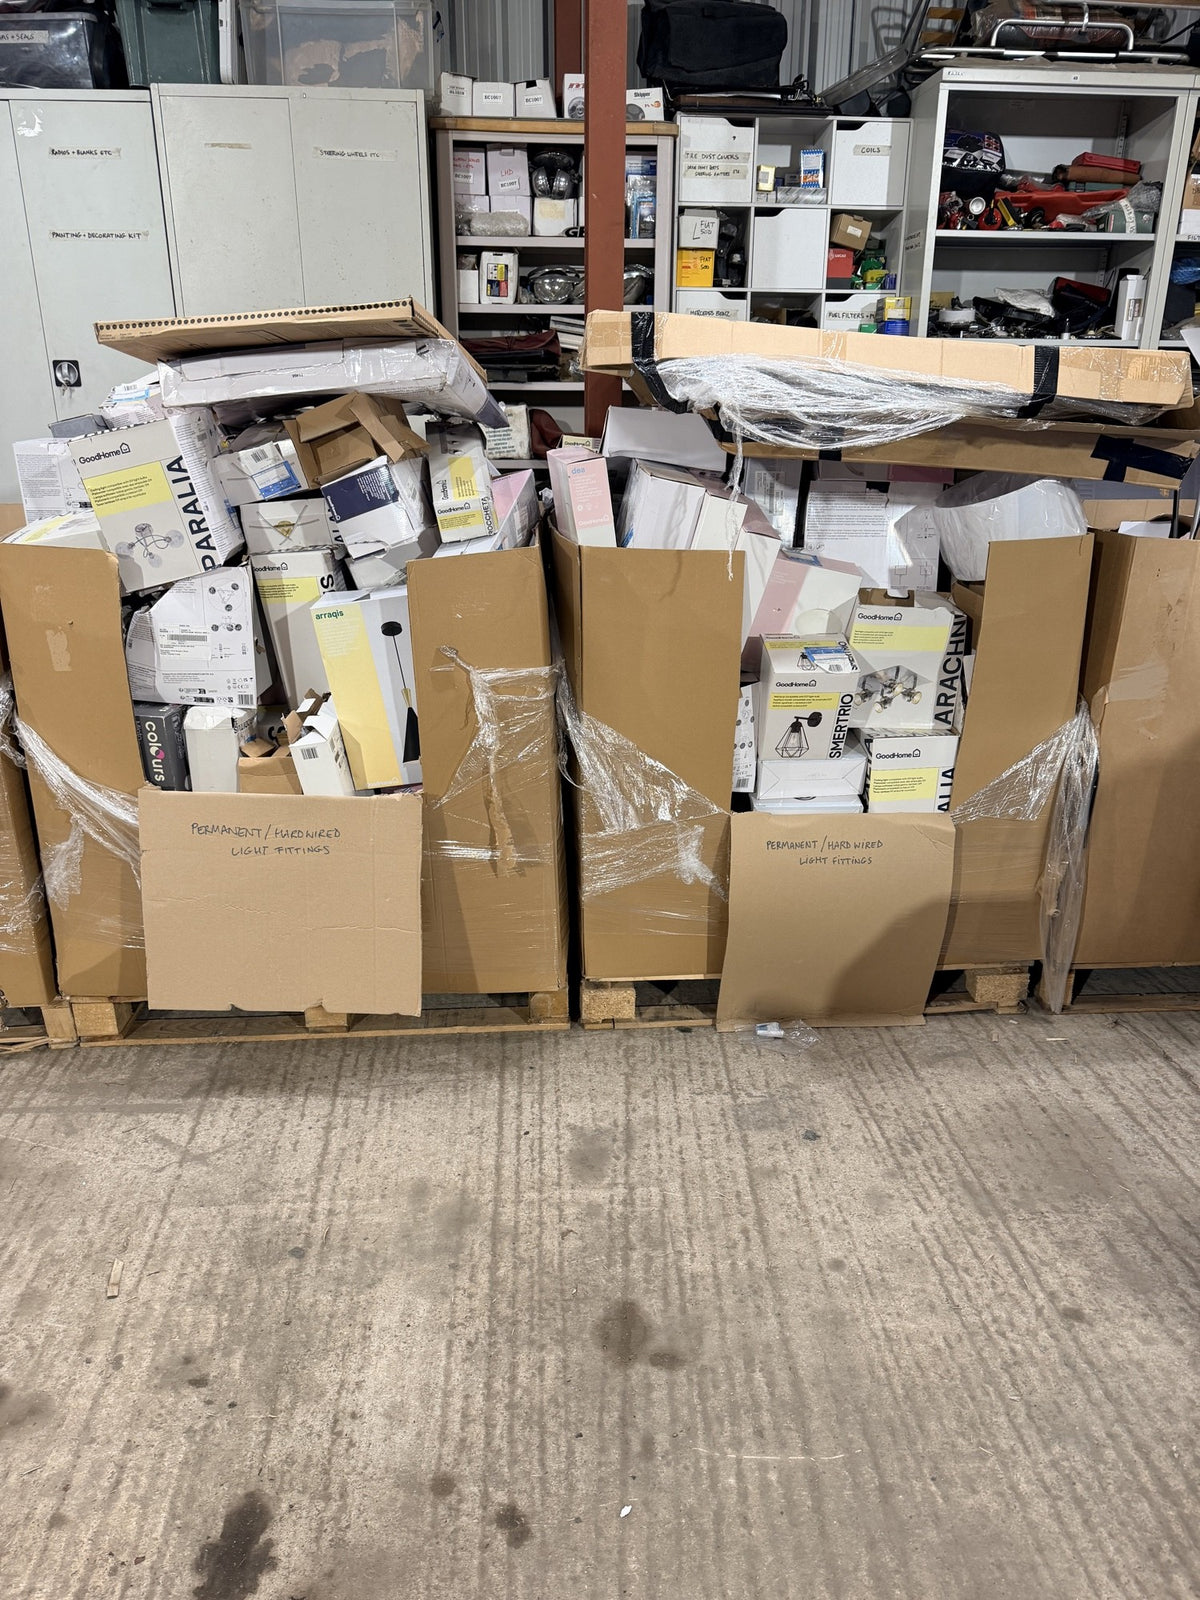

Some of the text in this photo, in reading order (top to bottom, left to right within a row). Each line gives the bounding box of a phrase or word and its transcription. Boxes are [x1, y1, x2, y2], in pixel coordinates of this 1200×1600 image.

[700, 220, 716, 228] FIAT
[78, 449, 120, 464] GoodHome
[166, 454, 220, 572] PARALIA
[437, 504, 464, 514] GoodHome
[315, 610, 344, 620] arraqis
[858, 612, 894, 620] GoodHome
[828, 694, 854, 759] SMERTRIO
[144, 721, 166, 782] colours
[231, 846, 330, 856] LIGHT FITTINGS
